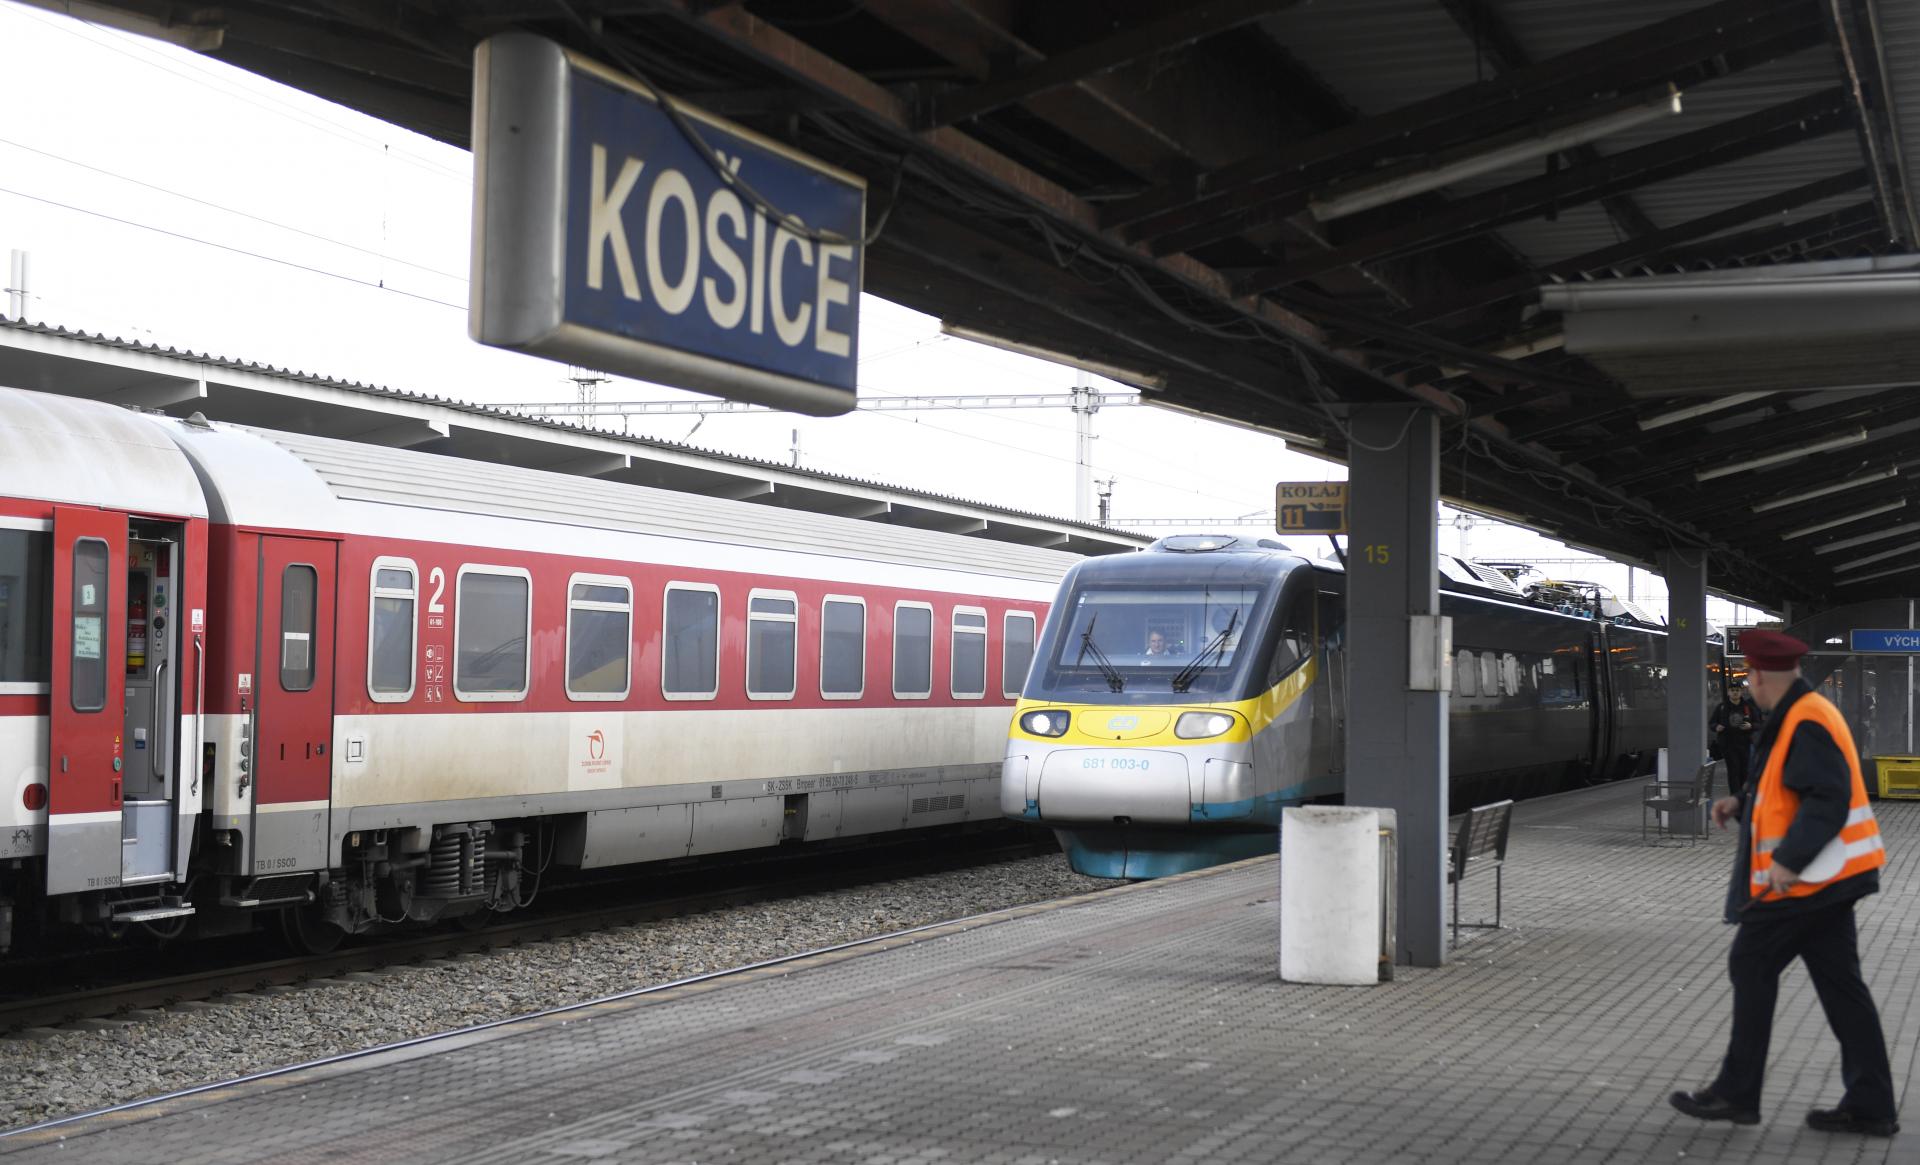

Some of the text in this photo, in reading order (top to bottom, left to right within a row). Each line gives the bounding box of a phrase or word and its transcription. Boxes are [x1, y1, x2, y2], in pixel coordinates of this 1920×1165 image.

[586, 143, 854, 358] KOŠICE
[1283, 508, 1305, 527] 11
[1364, 545, 1390, 565] 15
[428, 567, 445, 613] 2
[1083, 757, 1150, 771] 681 003-0
[256, 860, 266, 870] TB
[277, 857, 297, 869] SSOD
[88, 878, 95, 887] TB
[104, 875, 120, 886] SSOD
